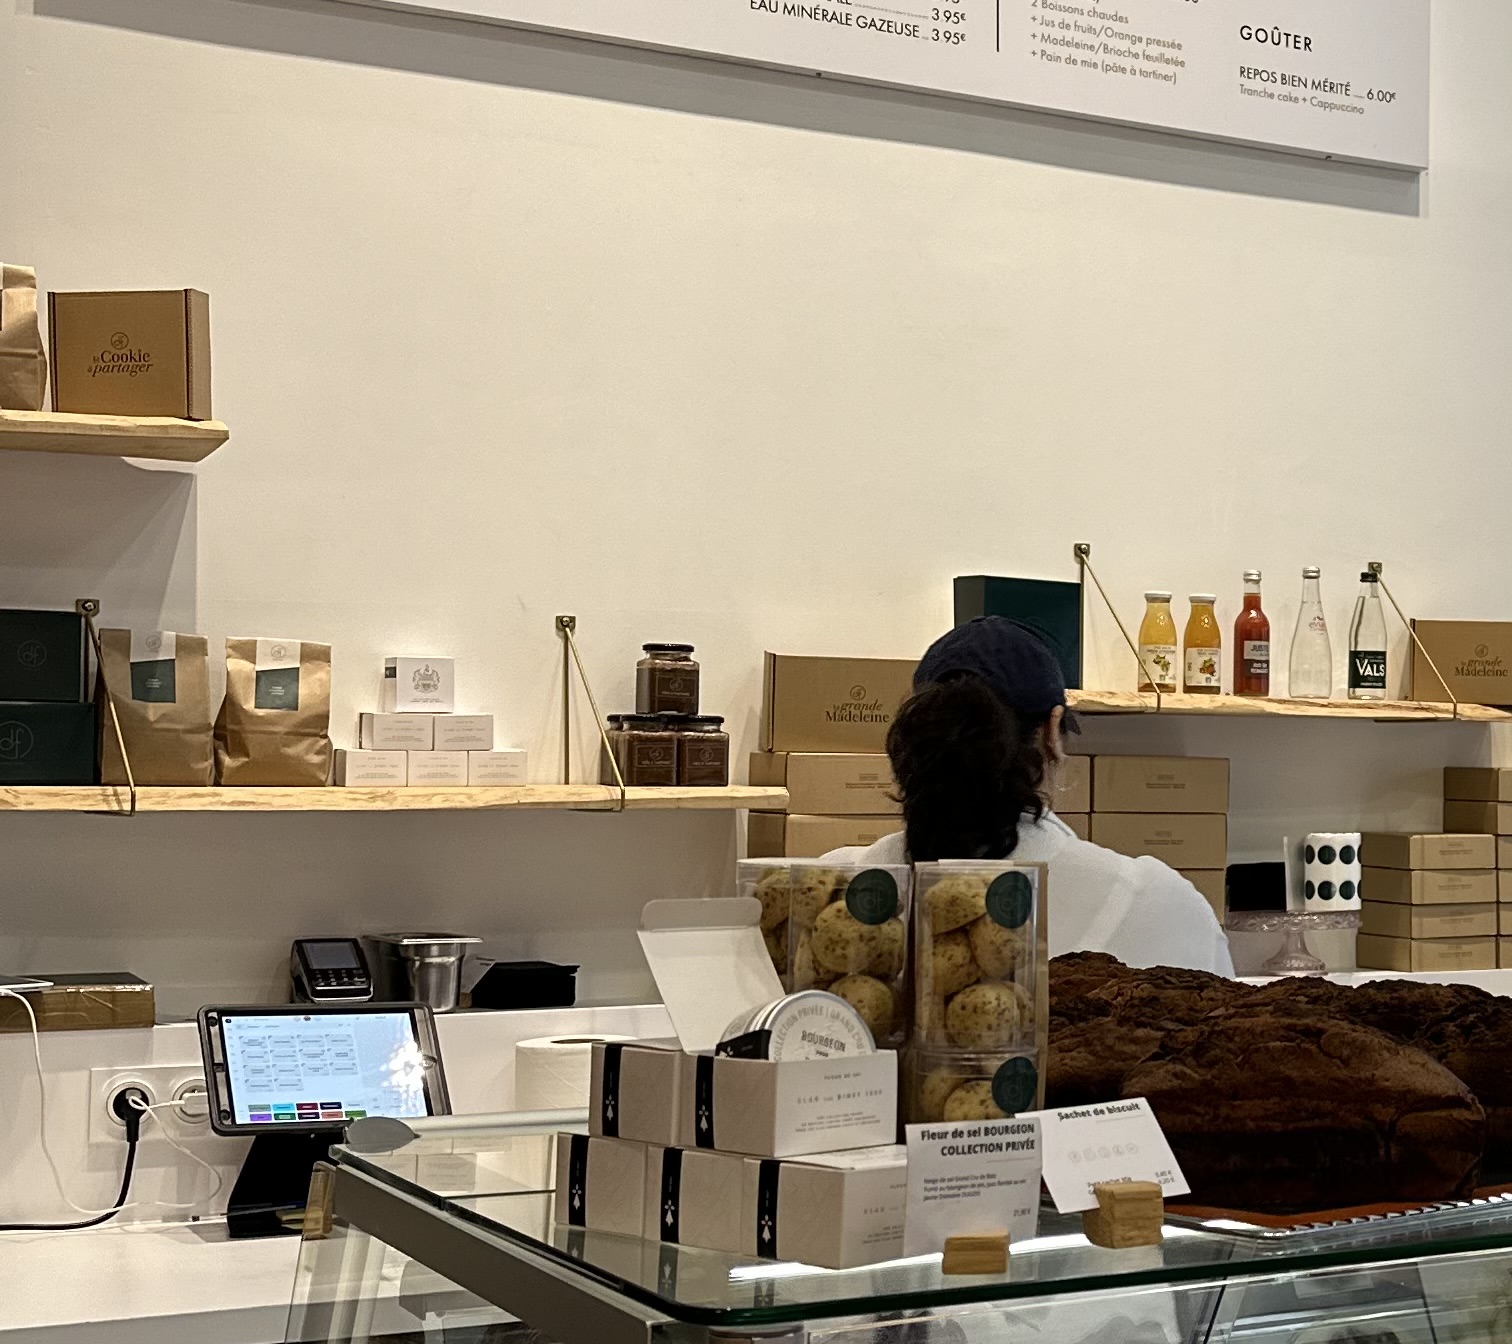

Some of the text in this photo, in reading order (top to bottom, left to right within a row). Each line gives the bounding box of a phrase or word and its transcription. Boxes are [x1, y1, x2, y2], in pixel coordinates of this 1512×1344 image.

[783, 2, 853, 27] MINÉRALE
[855, 14, 920, 39] GAZEUSE
[1239, 24, 1314, 53] GOÛTER
[1239, 65, 1278, 85] REPOS
[1280, 72, 1308, 89] BIEN
[1310, 77, 1351, 97] MÉRITÉ
[100, 348, 151, 364] Cookie
[91, 362, 154, 378] partager
[1454, 665, 1509, 677] Madeleine
[1468, 656, 1503, 668] grande
[839, 698, 884, 715] grande
[825, 710, 890, 723] Madeleine
[1057, 1102, 1141, 1122] Sachet de biscuit
[920, 1122, 1035, 1142] Fleur de sel BOURGEON
[940, 1137, 1036, 1157] COLLECTION PRIVÉE
